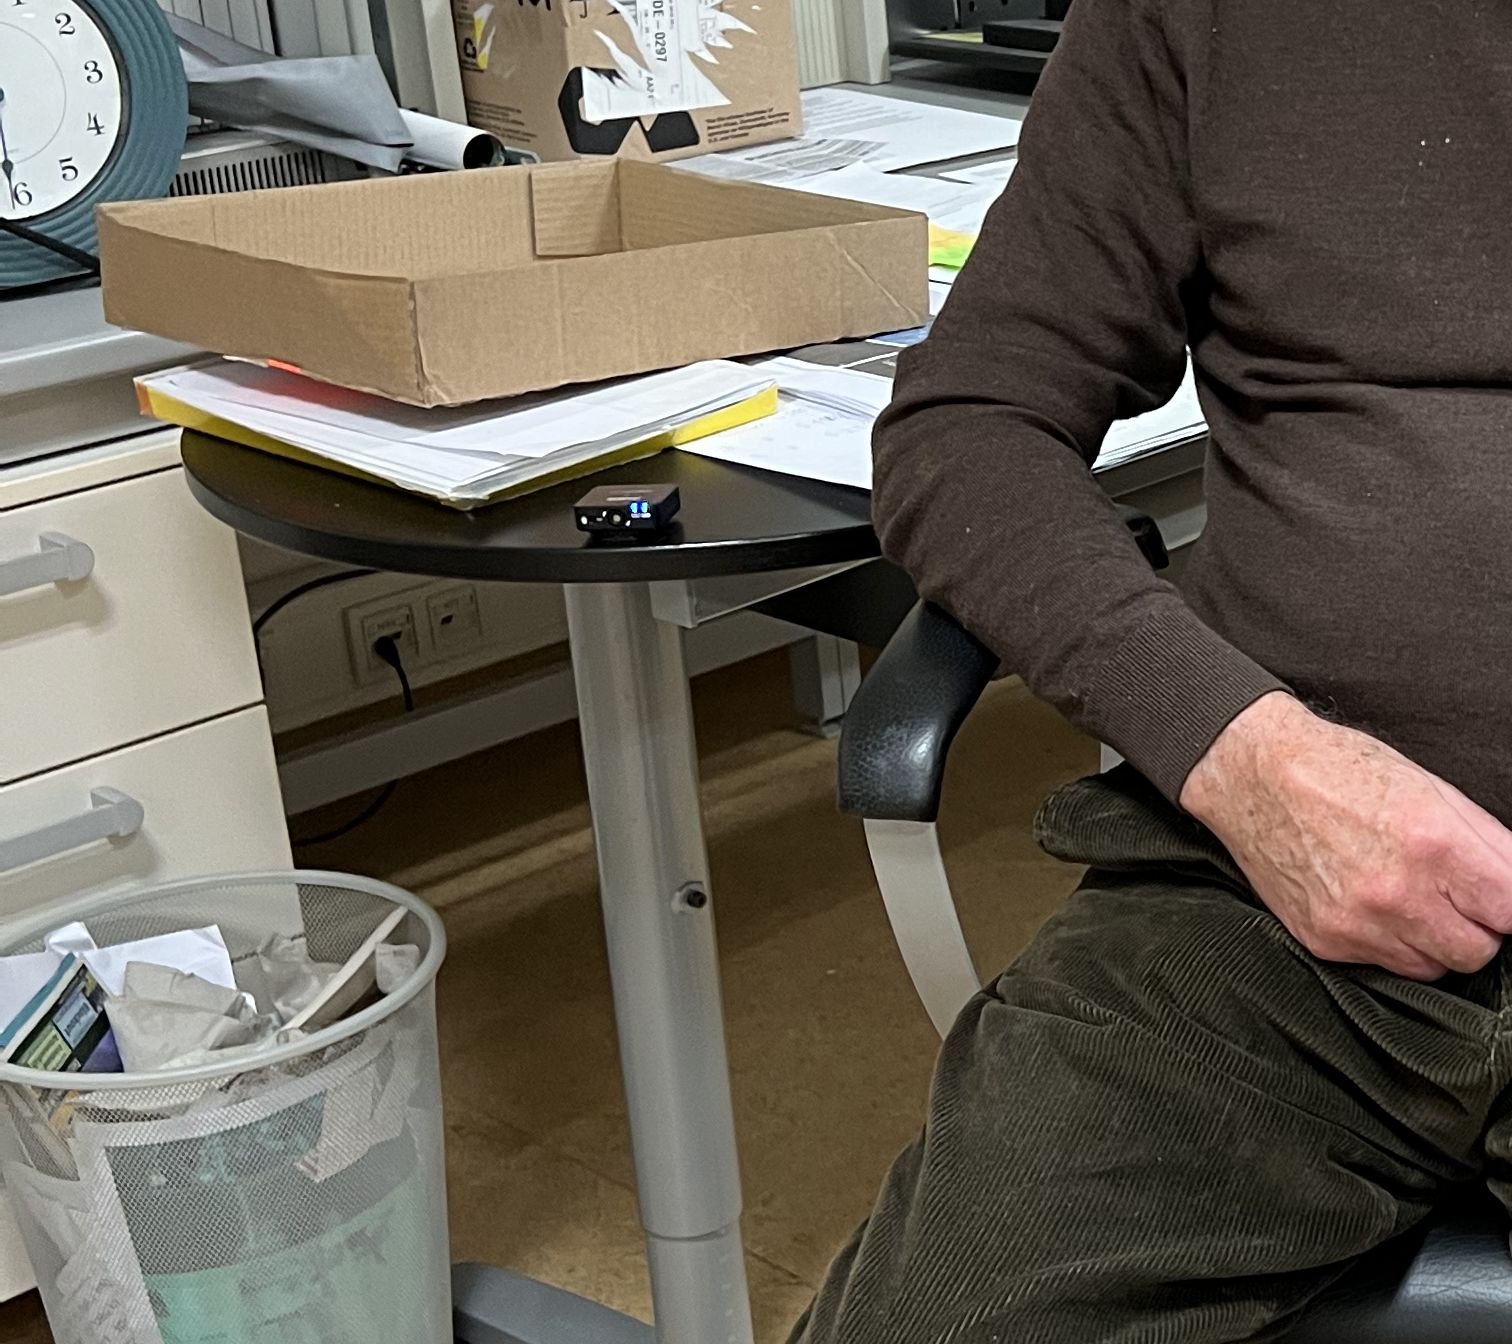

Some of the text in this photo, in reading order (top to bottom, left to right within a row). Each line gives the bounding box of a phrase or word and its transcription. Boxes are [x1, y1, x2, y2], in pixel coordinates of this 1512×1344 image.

[55, 13, 76, 36] 2
[84, 60, 103, 84] 3
[86, 112, 104, 136] 4
[59, 157, 78, 182] 5
[13, 182, 33, 206] 6
